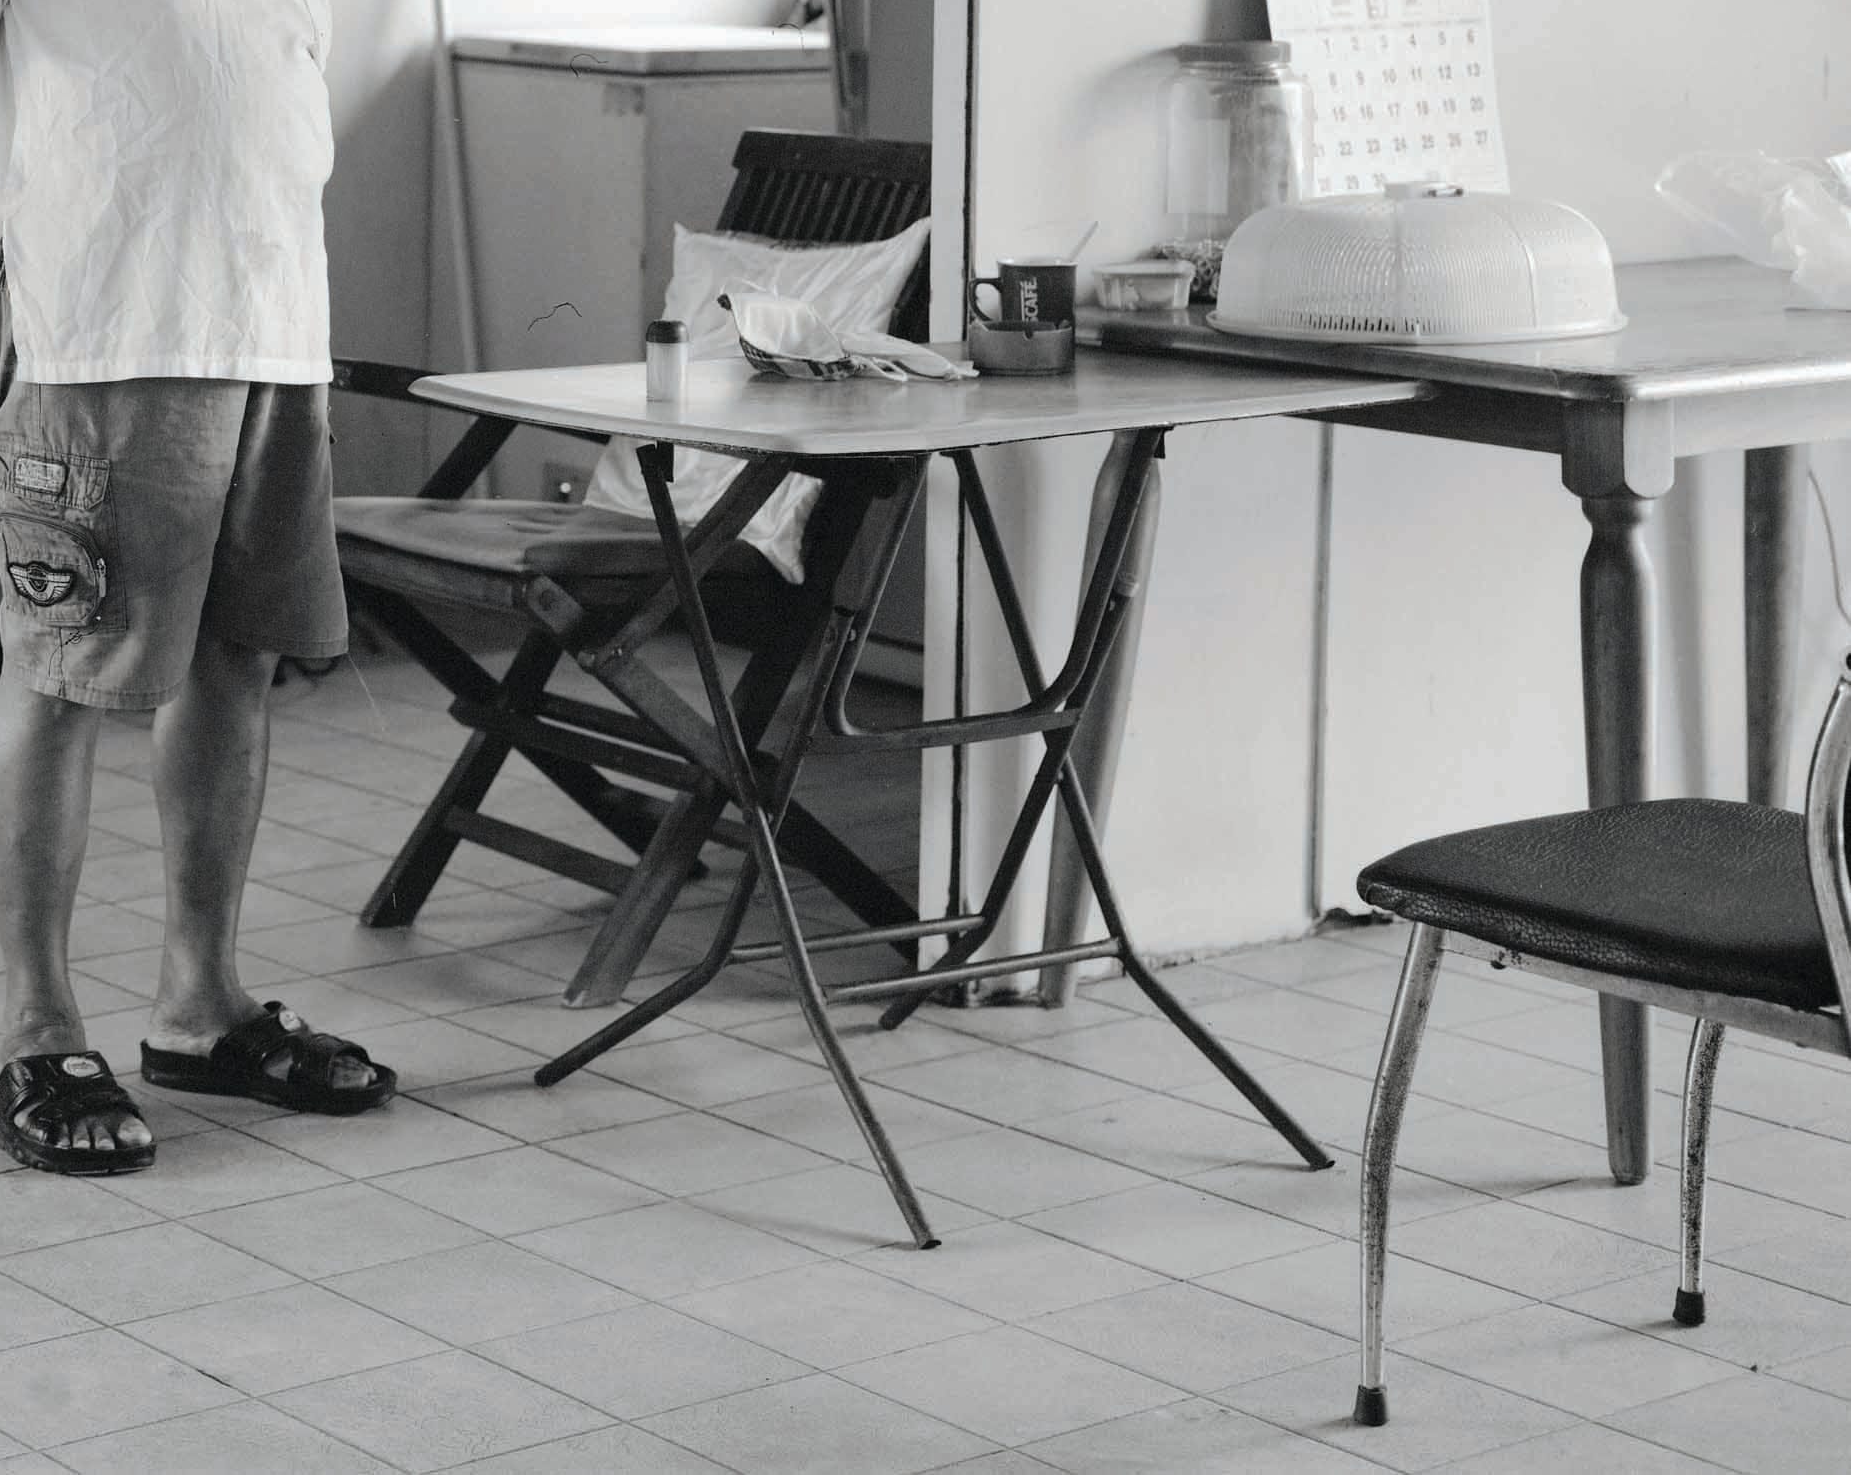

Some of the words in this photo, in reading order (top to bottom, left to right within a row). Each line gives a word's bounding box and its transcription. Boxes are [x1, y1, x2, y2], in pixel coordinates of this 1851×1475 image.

[1409, 34, 1416, 47] 4
[1438, 32, 1446, 45] 5
[1467, 30, 1475, 44] 6
[1382, 69, 1396, 84] 10
[1411, 67, 1422, 81] 11
[1438, 65, 1452, 80] 12
[1467, 63, 1481, 77] 13
[1333, 107, 1346, 122] 15
[1360, 105, 1373, 119] 16
[1387, 103, 1400, 117] 17
[1470, 97, 1483, 112] 20
[1339, 141, 1352, 156] 22
[1366, 139, 1380, 153] 23
[1394, 137, 1407, 152] 24
[1422, 135, 1434, 149] 25
[1020, 277, 1039, 322] SCAFÉ
